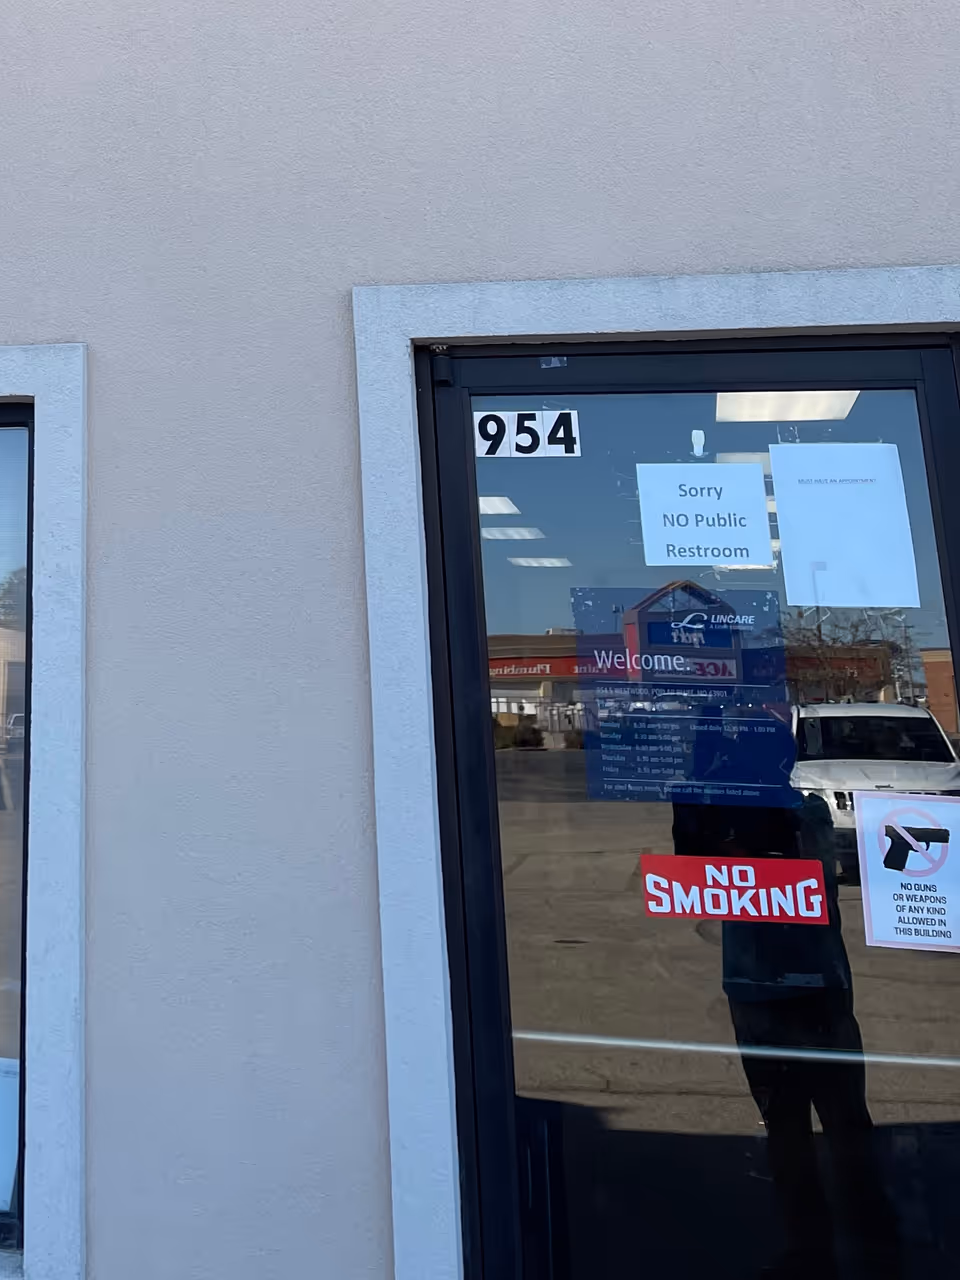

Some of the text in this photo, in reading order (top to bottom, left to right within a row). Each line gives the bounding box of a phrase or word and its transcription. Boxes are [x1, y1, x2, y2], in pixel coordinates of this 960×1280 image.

[478, 412, 577, 456] 954
[678, 483, 723, 500] Sorry
[663, 513, 747, 528] NO Public
[666, 543, 750, 558] Restroom
[711, 614, 755, 624] LINCARE
[705, 865, 756, 887] NO
[900, 883, 938, 893] NO GUNS
[645, 873, 823, 918] SMOKING
[893, 893, 947, 904] OR WEAPONS
[896, 905, 946, 916] OF ANY KIND
[897, 916, 947, 927] ALLOWED IN
[894, 927, 952, 939] THIS BUILDING
